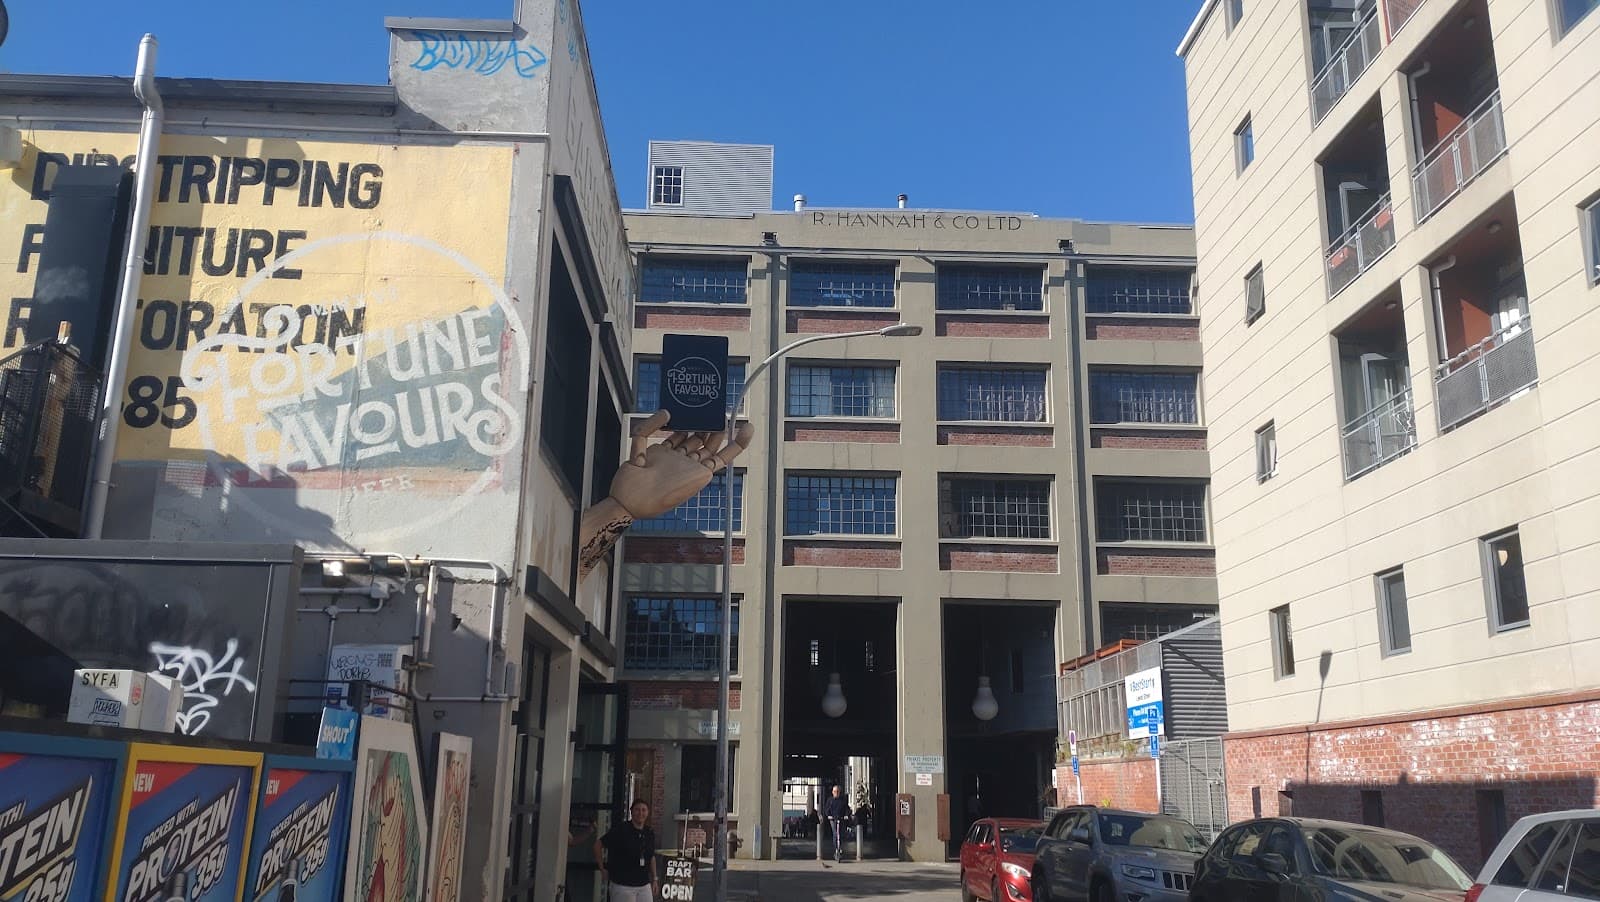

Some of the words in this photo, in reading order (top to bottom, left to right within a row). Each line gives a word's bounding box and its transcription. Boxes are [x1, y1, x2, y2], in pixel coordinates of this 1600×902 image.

[31, 151, 384, 210] DTRIPPING
[837, 212, 926, 229] HANNAH
[933, 215, 946, 229] &
[952, 215, 979, 230] CO
[987, 216, 1022, 231] LTD
[17, 223, 307, 280] FNITURE
[4, 297, 366, 356] RORATION
[180, 305, 501, 423] FORTUNE
[667, 366, 717, 385] FORTUNE
[674, 384, 719, 399] FAVOURS
[241, 373, 522, 481] FAVOURS
[82, 672, 118, 687] SYFA
[125, 788, 234, 902] PROTEIN
[141, 815, 175, 853] PACKED
[255, 791, 334, 892] PROTEIN
[666, 867, 692, 878] BAR
[667, 860, 693, 868] CRAFT
[661, 883, 695, 900] OPEN
